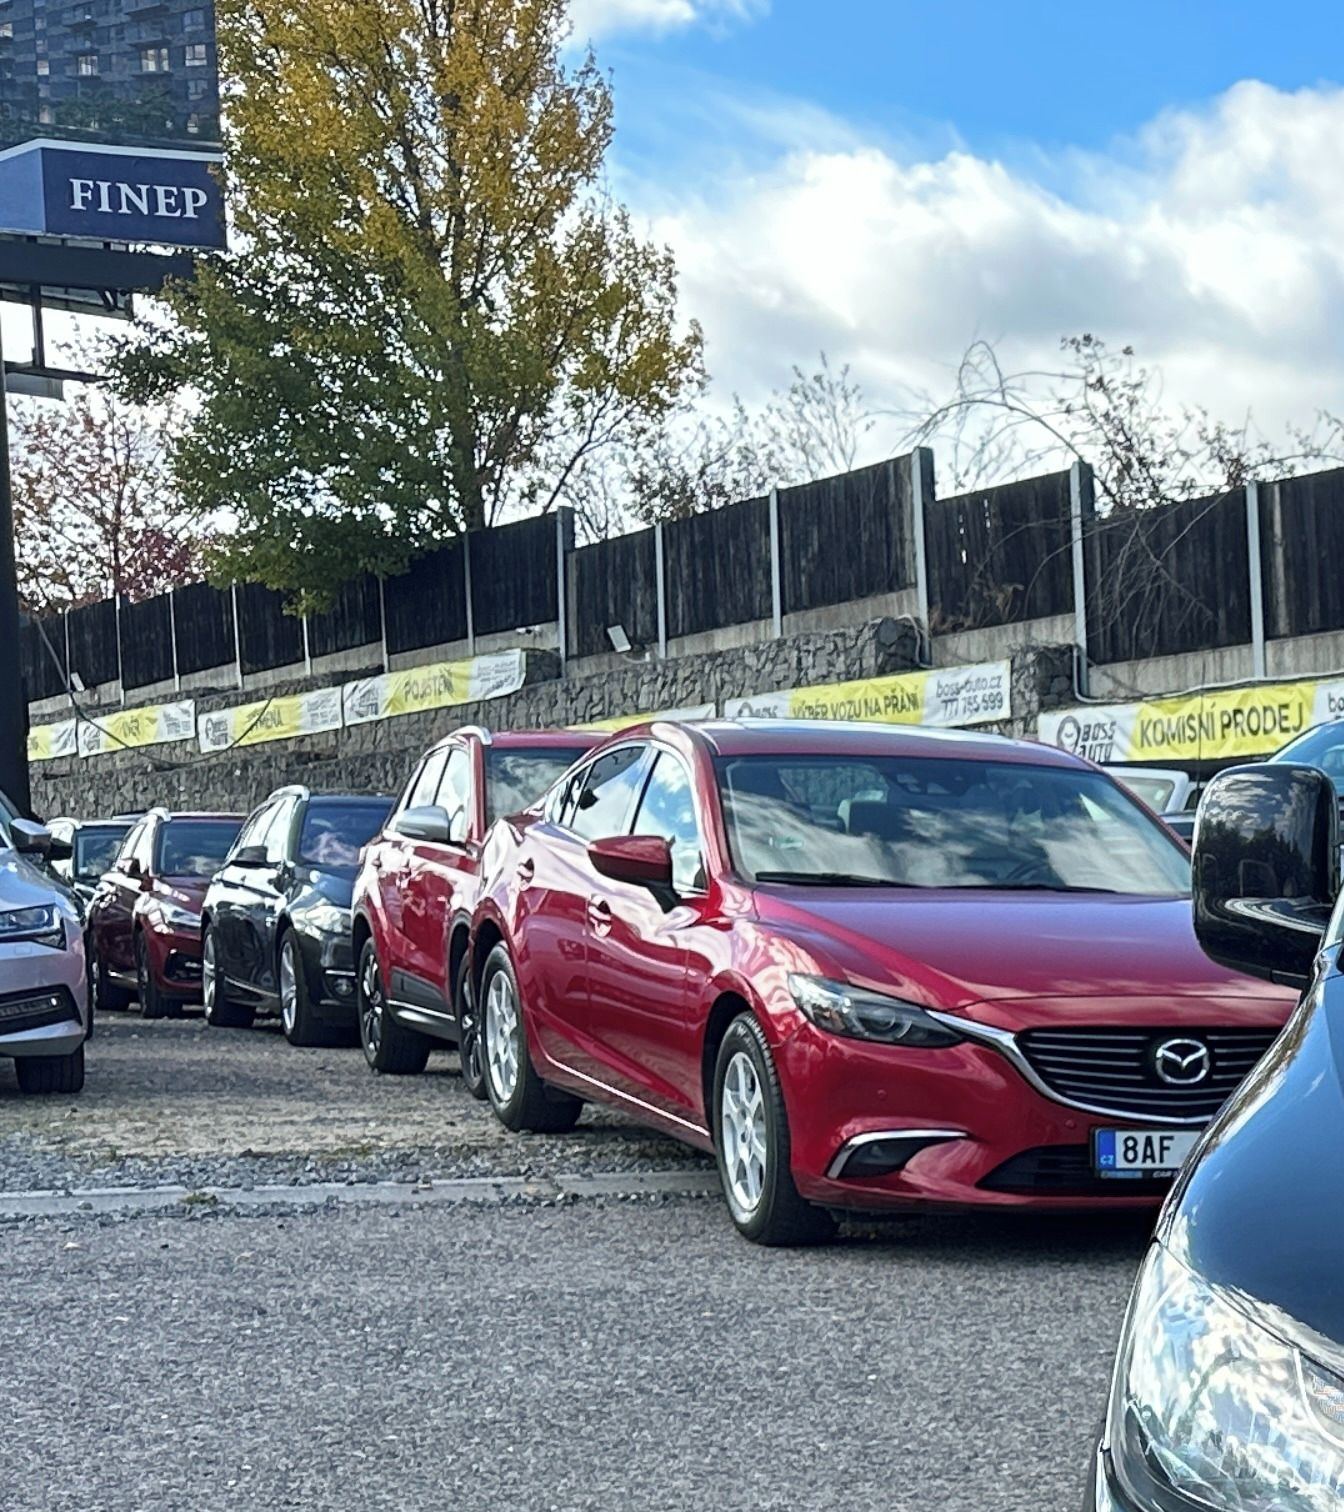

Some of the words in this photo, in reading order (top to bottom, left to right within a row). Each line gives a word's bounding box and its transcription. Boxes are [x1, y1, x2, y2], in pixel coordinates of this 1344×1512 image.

[69, 178, 207, 218] FINEP
[864, 697, 882, 716] NA
[1081, 721, 1117, 742] BOSS
[1140, 702, 1217, 749] KOMISNÍ
[1220, 702, 1303, 739] PRODEJ
[1123, 1136, 1174, 1164] 8AF
